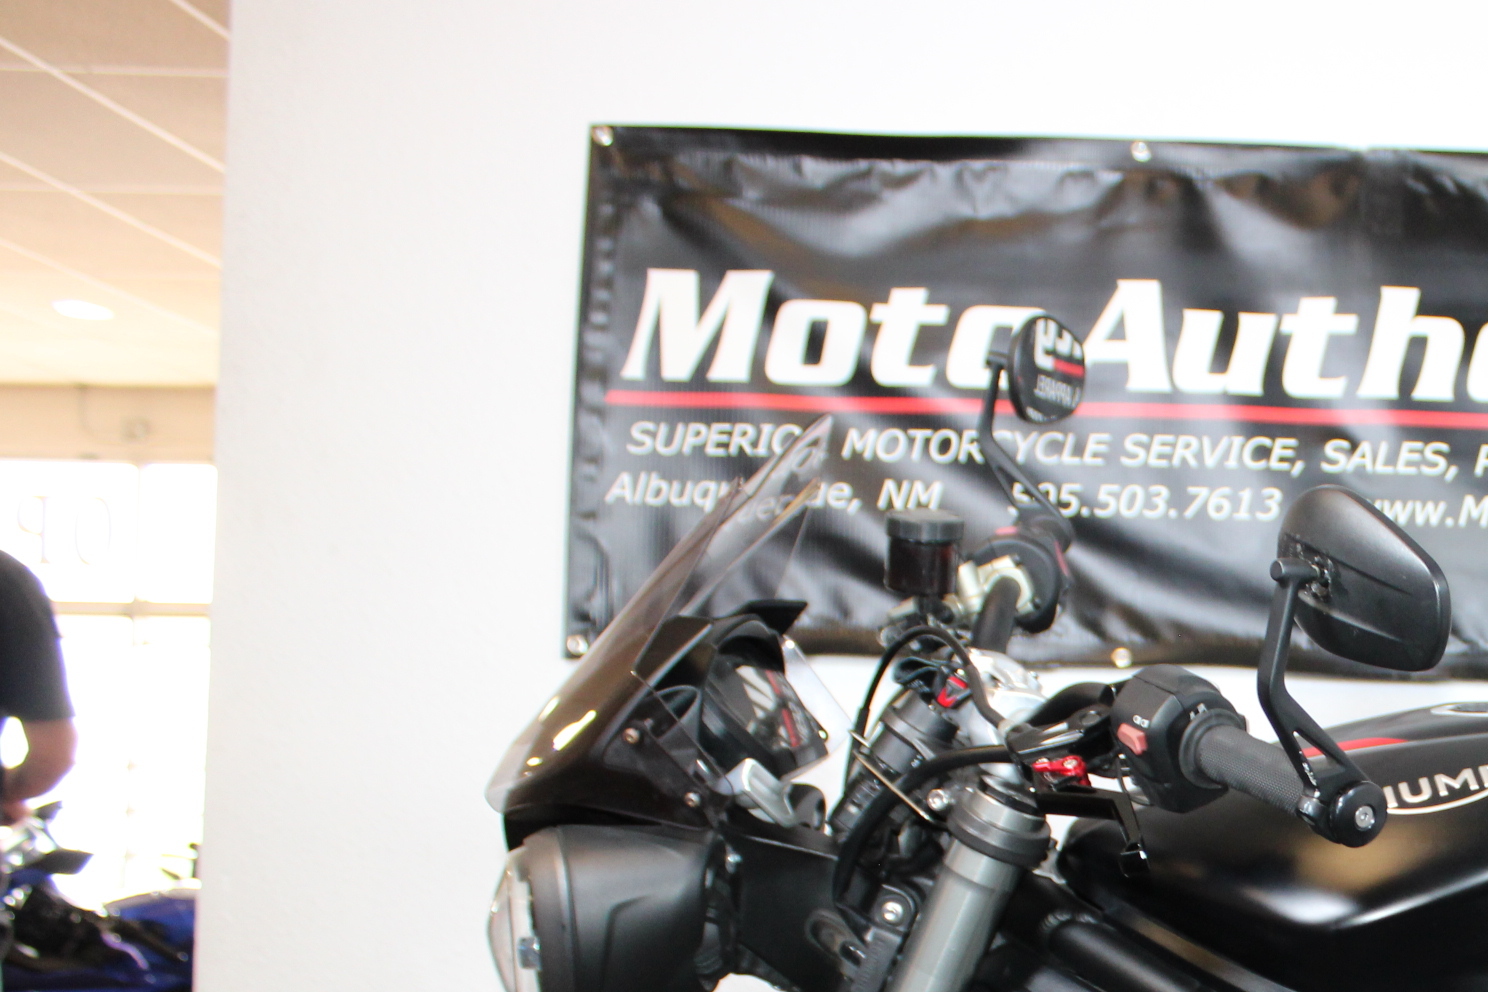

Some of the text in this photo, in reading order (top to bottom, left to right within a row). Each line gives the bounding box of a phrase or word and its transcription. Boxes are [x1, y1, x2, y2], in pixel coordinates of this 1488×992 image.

[621, 268, 1047, 389] Moto
[1120, 432, 1306, 477] SERVICE,
[1320, 438, 1459, 482] SALES,
[605, 471, 863, 518] Albuquerue,
[877, 477, 944, 511] NM
